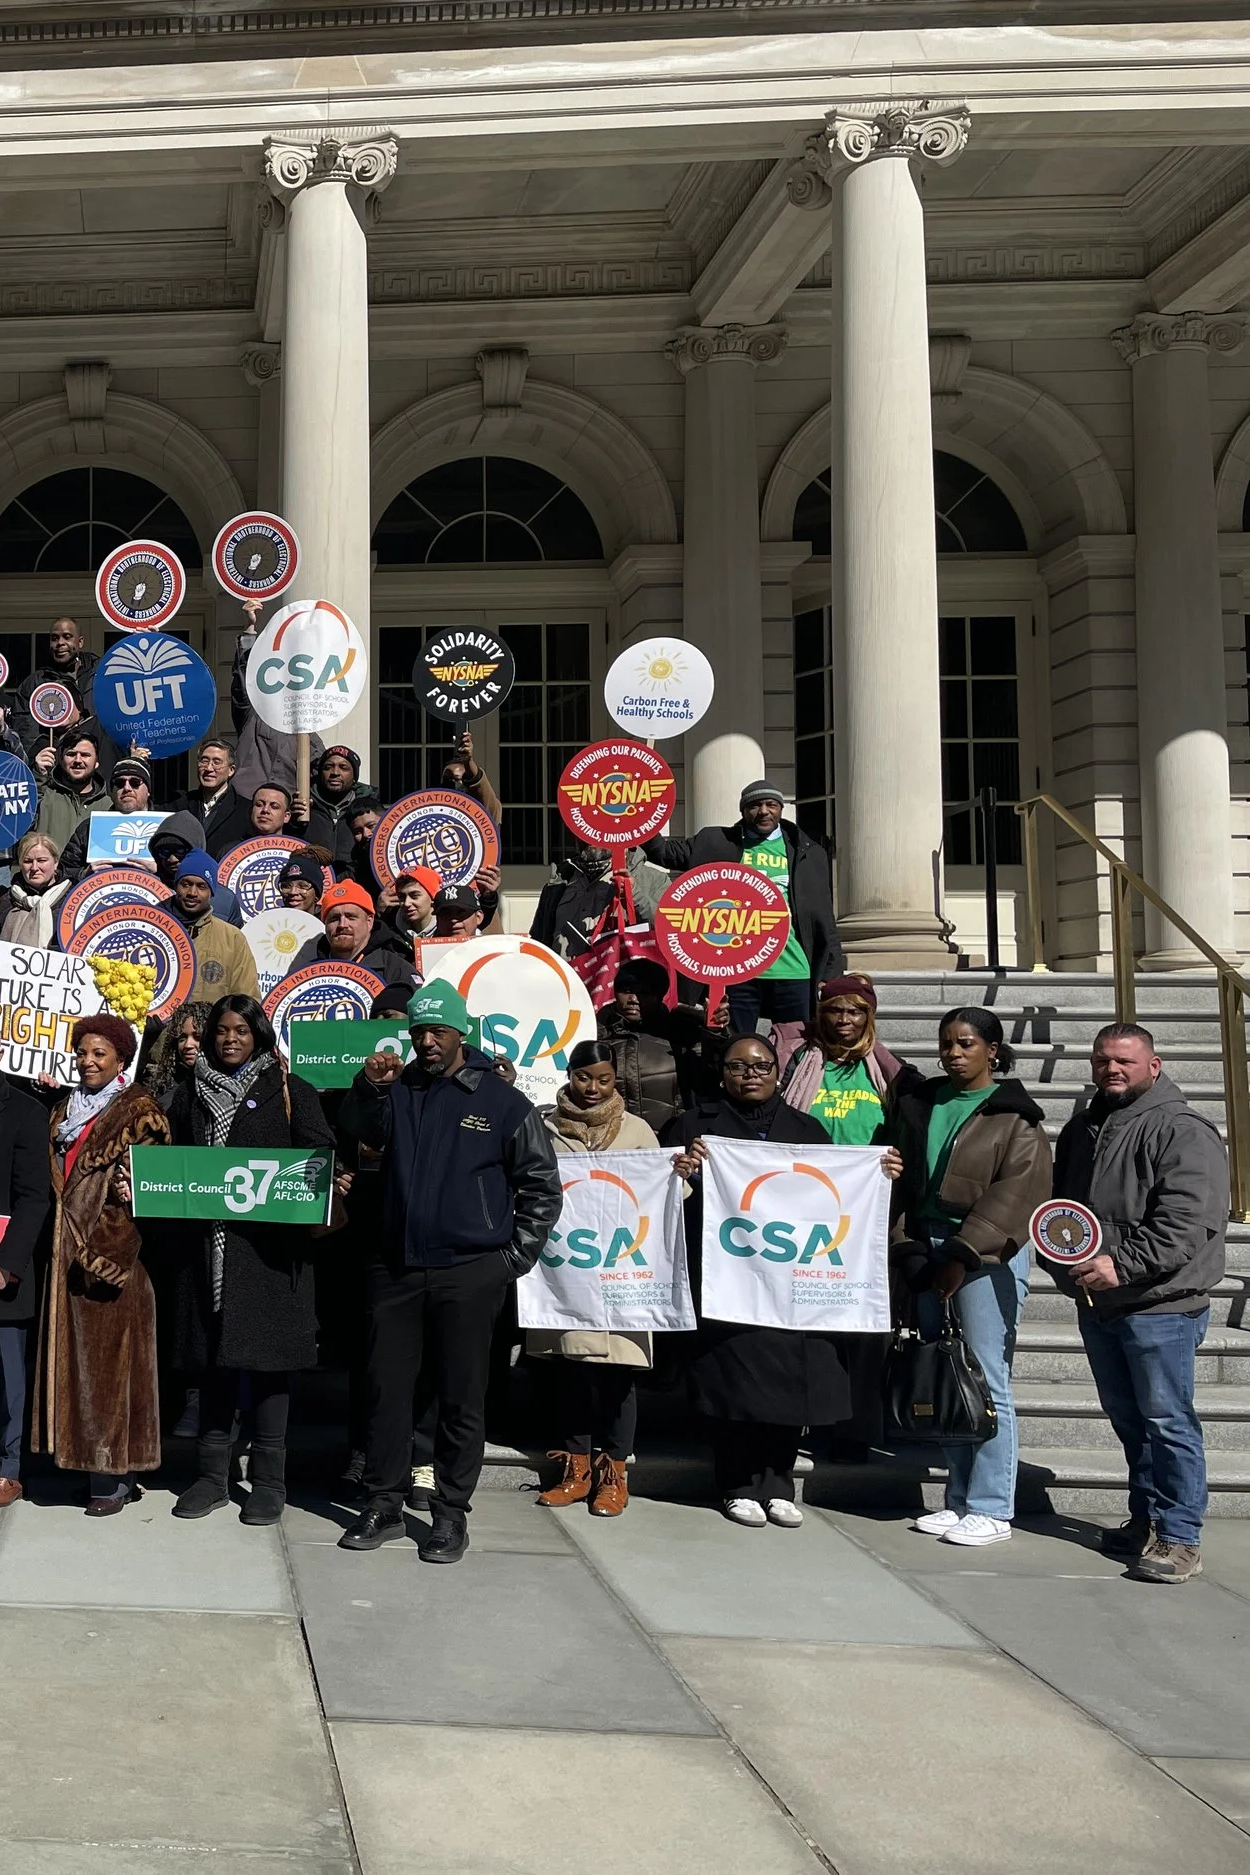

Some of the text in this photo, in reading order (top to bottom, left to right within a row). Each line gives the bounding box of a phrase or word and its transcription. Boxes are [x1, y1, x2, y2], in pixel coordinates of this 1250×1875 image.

[272, 534, 281, 543] OF
[156, 562, 165, 571] OF
[424, 632, 505, 664] SOLIDARITY
[255, 650, 356, 694] CSA
[441, 665, 484, 681] NYSNA
[114, 674, 187, 715] UFT
[324, 694, 350, 704] SCHOOL
[426, 681, 502, 713] FOREVER
[622, 695, 690, 708] Carbon Free &
[115, 714, 200, 732] United Federation
[616, 706, 694, 720] Healthy Schools
[130, 725, 187, 740] of Teachers
[569, 745, 663, 780] DEFENDING OUR PATIENTS,
[5, 798, 30, 815] NY
[581, 780, 652, 806] NYSNA
[376, 793, 495, 878] ABORERS' INTERNATIONAL UNION
[569, 802, 668, 843] HOSPITALS, UNION & PRACTICE
[115, 839, 149, 855] UF
[388, 807, 479, 869] JUSTICE HONOR STRENGTH
[397, 823, 472, 871] 79
[63, 875, 105, 925] LABORERS'
[670, 868, 778, 906] DEFENDING OUR PATIENTS,
[80, 886, 149, 918] JUSTICE HONOR
[680, 907, 761, 936] NYSNA
[90, 908, 191, 970] INTERNATIONAL UNION
[106, 921, 176, 962] HONOR STRENGTH
[10, 947, 86, 985] SOLAR
[667, 933, 780, 977] HOSPITALS, UNION & PRACTICE
[291, 964, 381, 994] INTERNATIONAL
[60, 987, 82, 1016] IS
[274, 996, 293, 1030] JUSTICE
[308, 978, 340, 987] HONOR
[482, 1012, 571, 1072] SA
[1, 1043, 81, 1083] UTURE
[296, 1053, 337, 1064] District
[525, 1074, 558, 1085] SCHOOL
[824, 1107, 849, 1118] WAY
[835, 1098, 857, 1110] THE
[140, 1181, 232, 1194] District Council
[223, 1159, 280, 1214] 37
[273, 1180, 316, 1191] AFSCME
[273, 1191, 316, 1202] AFL-CIO
[538, 1225, 649, 1269] CSA
[719, 1216, 848, 1266] CSA
[599, 1271, 654, 1281] SINCE 1962
[600, 1282, 651, 1292] COUNCIL OF
[791, 1281, 830, 1289] COUNCIL
[843, 1281, 875, 1290] SCHOOL
[792, 1269, 847, 1279] SINCE 1962
[602, 1298, 672, 1307] ADMINISTRATORS
[791, 1289, 846, 1298] SUPERVISORS
[791, 1297, 860, 1306] ADMINISTRATORS
